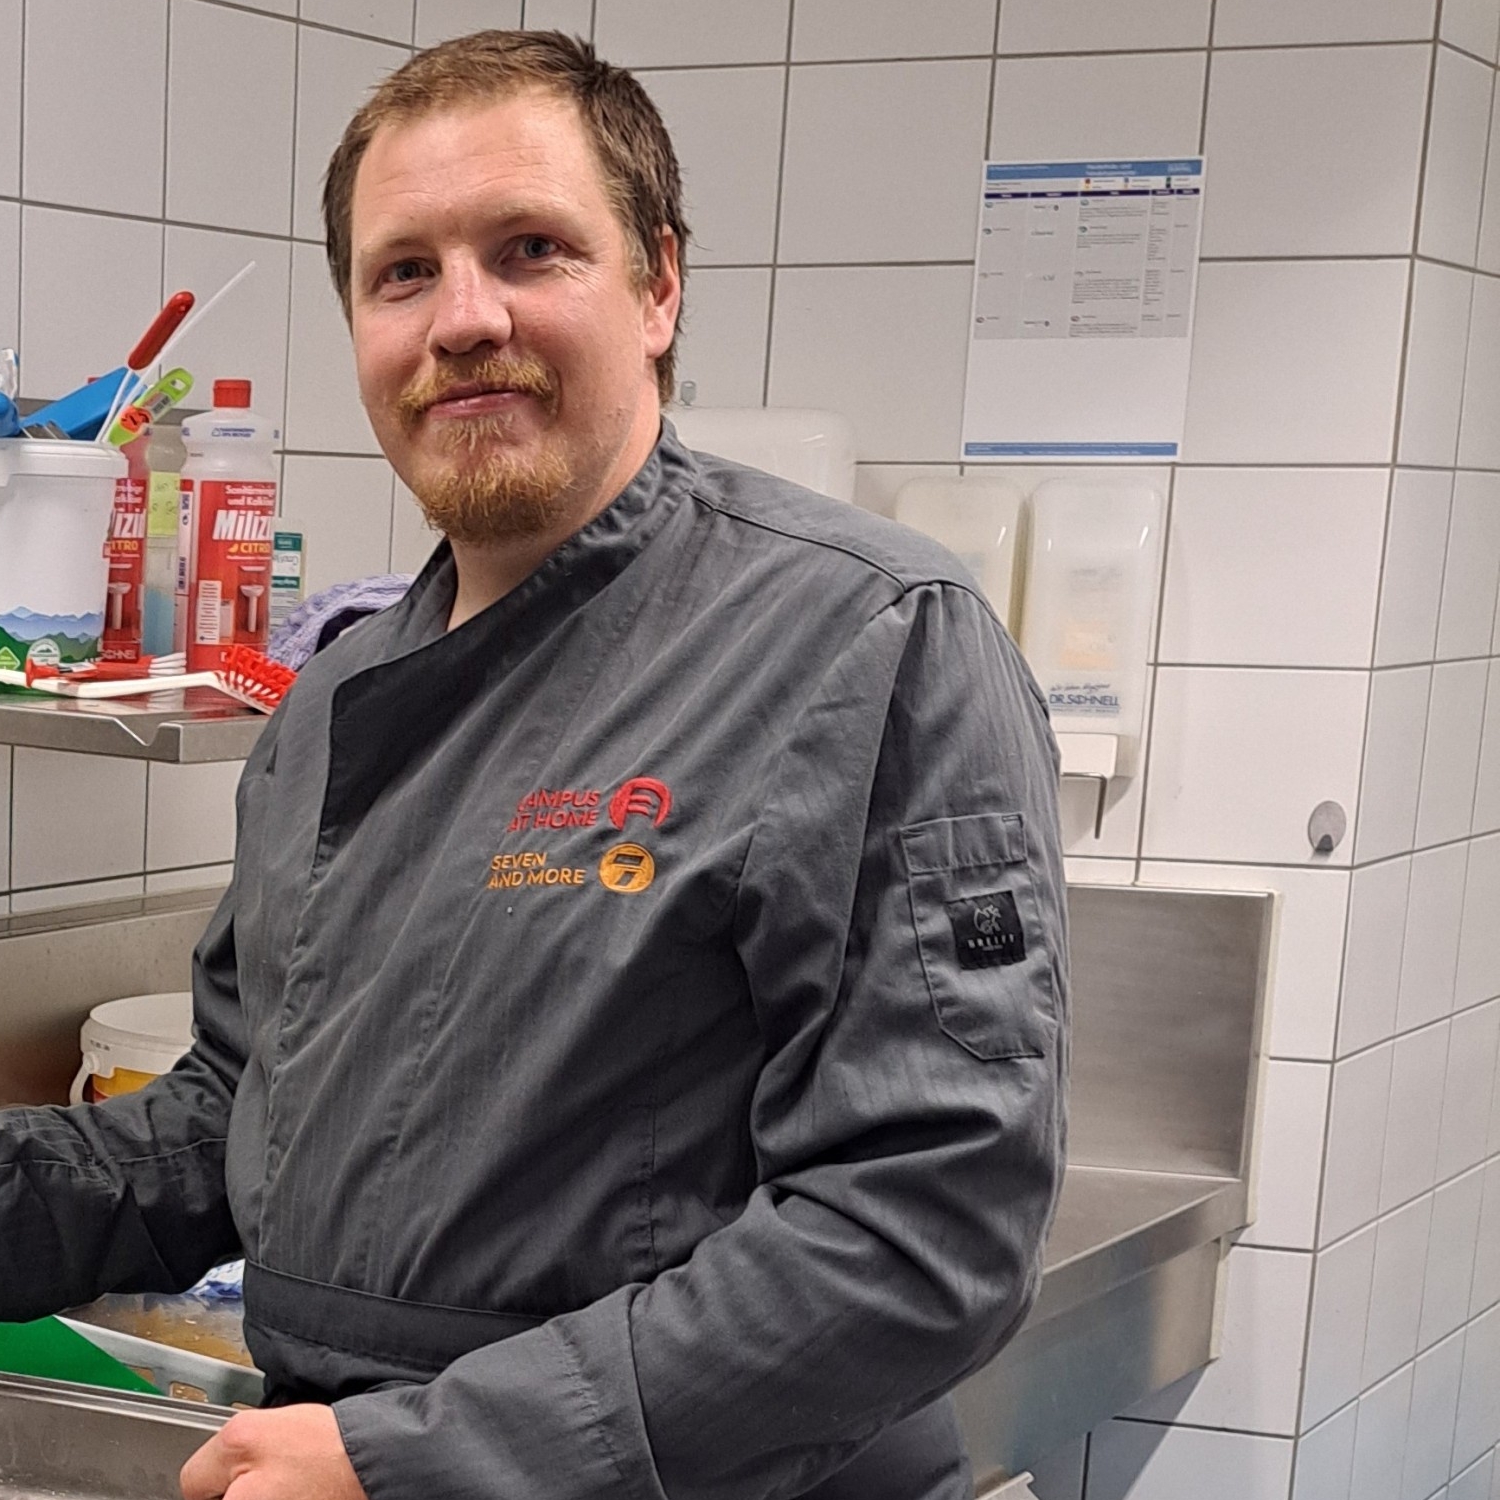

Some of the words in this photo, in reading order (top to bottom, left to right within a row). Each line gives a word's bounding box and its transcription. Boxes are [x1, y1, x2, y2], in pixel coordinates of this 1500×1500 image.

[533, 809, 599, 831] HOME
[491, 852, 547, 871] SEVEN
[487, 870, 524, 889] AND
[526, 867, 587, 885] MORE
